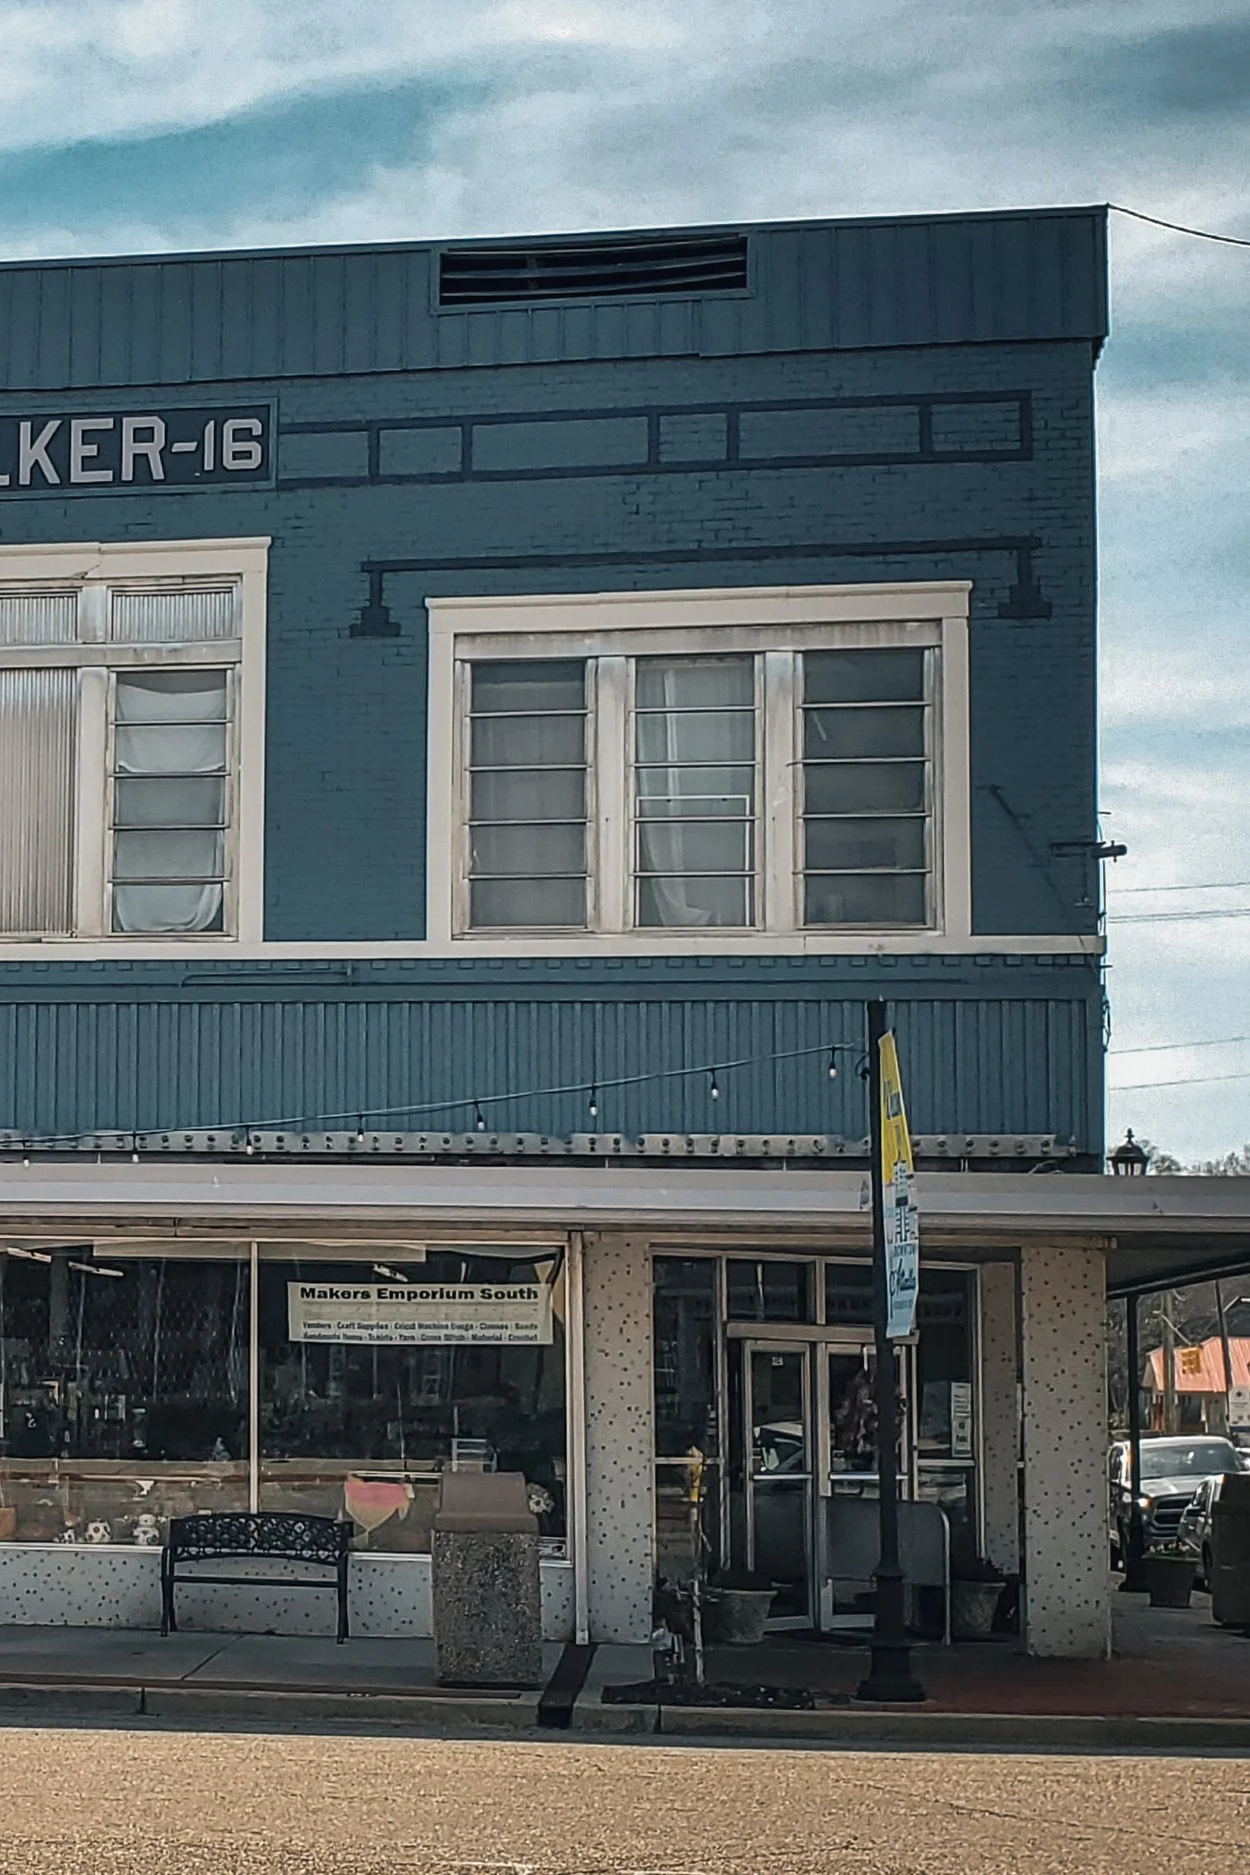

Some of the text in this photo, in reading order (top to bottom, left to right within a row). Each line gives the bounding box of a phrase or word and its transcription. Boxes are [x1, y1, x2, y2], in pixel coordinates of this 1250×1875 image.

[300, 1287, 539, 1302] Makers Emporium South
